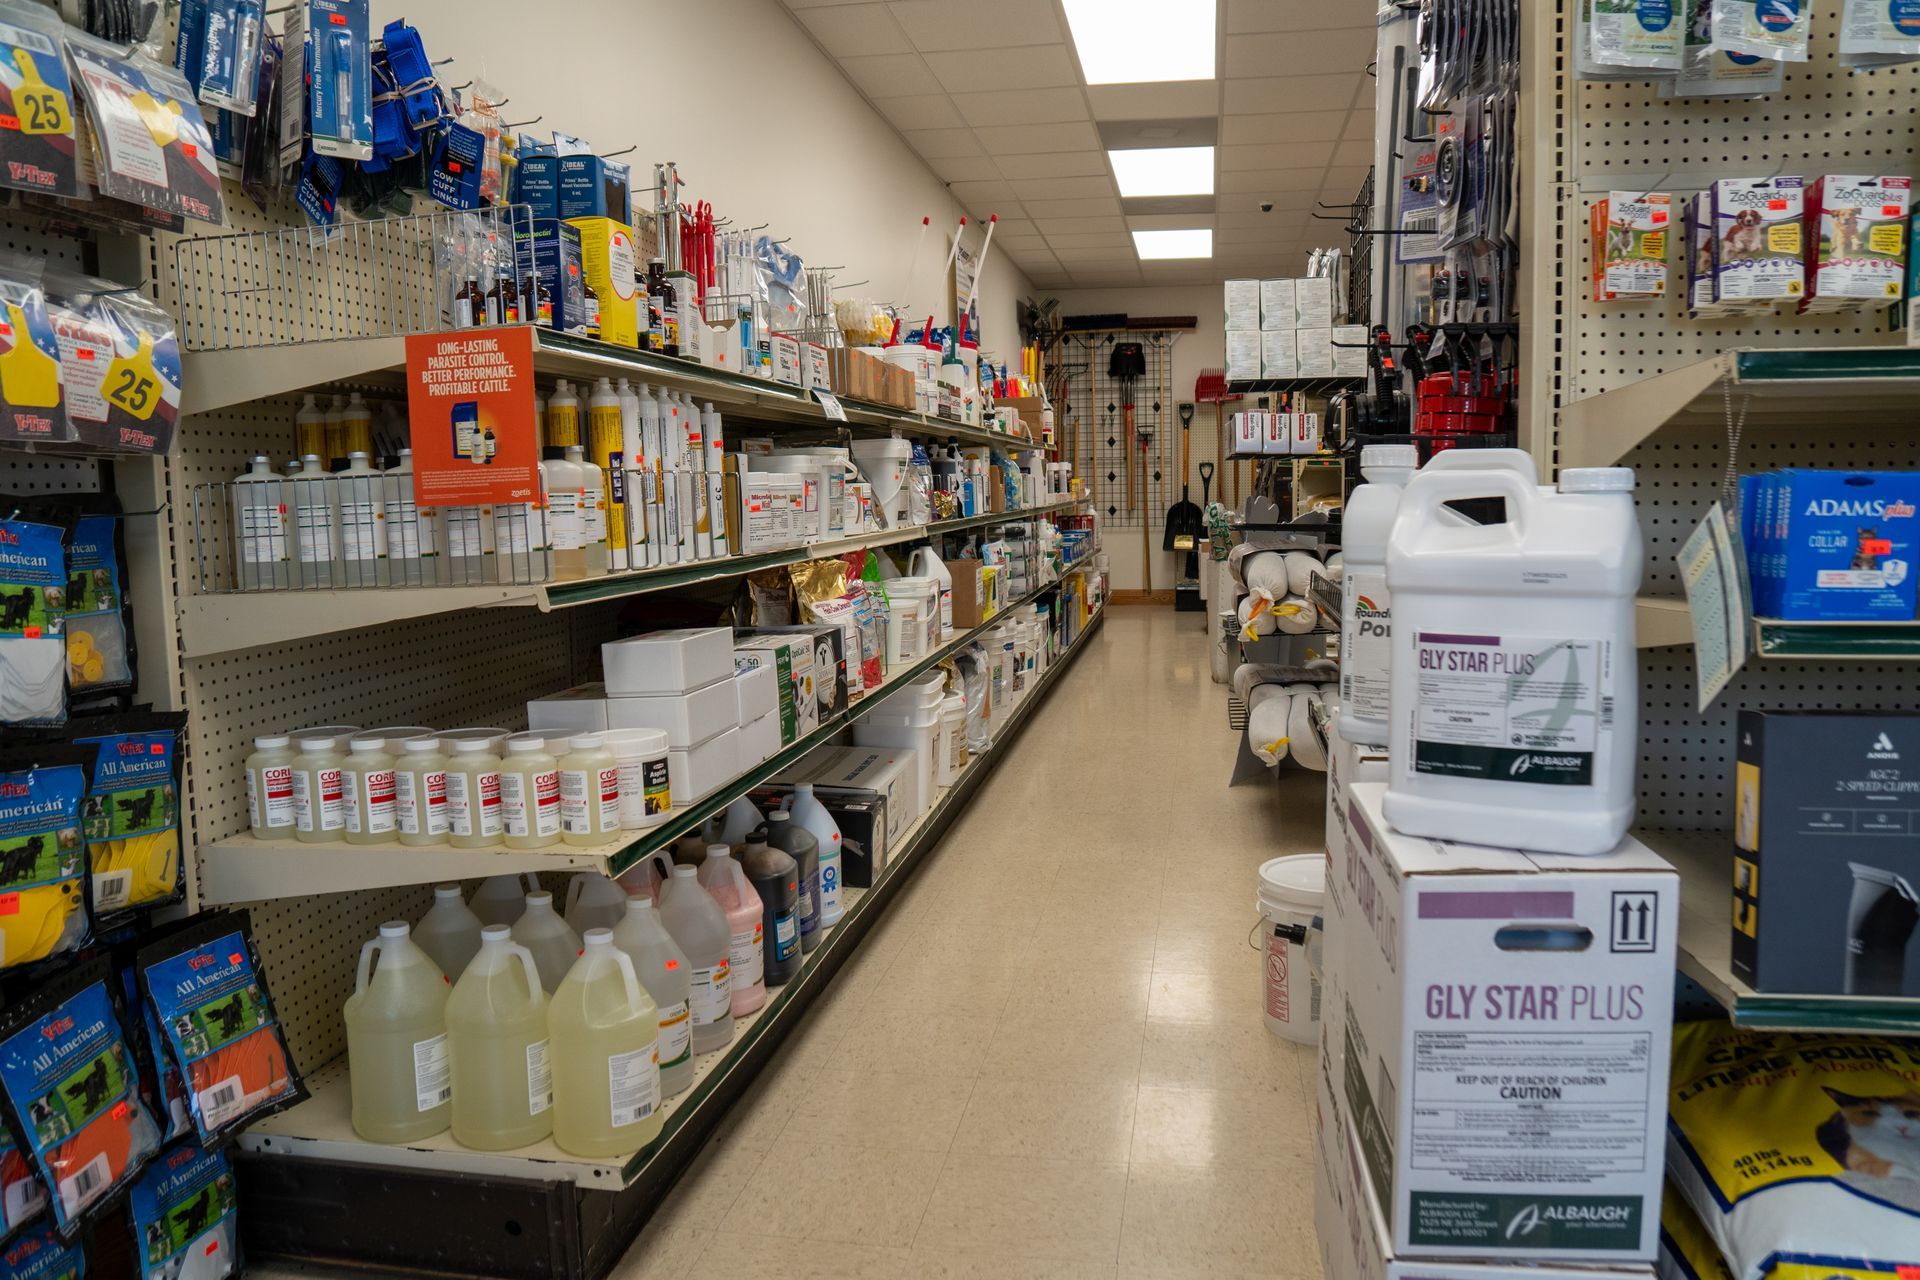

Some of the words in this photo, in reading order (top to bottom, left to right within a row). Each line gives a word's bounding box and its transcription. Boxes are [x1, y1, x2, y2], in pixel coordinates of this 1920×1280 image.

[25, 95, 61, 130] 25
[316, 92, 324, 119] Mercury
[433, 169, 454, 183] COW
[303, 177, 320, 197] COW
[432, 179, 455, 194] CUFF
[1834, 188, 1884, 200] ZoGuard
[301, 187, 321, 208] CUFF
[432, 188, 459, 205] LINKS
[1750, 201, 1768, 209] DOG
[299, 194, 320, 220] LINKS
[437, 338, 498, 356] LONG-LASTING
[428, 353, 467, 370] PARASITE
[468, 352, 509, 367] CONTROL.
[422, 369, 452, 384] BETTER
[454, 365, 517, 381] PERFORMANCE.
[110, 368, 154, 411] 25
[429, 380, 478, 396] PROFITABLE
[479, 379, 511, 393] CATTLE.
[511, 487, 531, 498] zoetis
[1804, 499, 1885, 517] ADAMS
[1882, 499, 1917, 522] plus
[71, 543, 97, 554] rican
[1808, 535, 1848, 548] COLLAR
[0, 552, 47, 566] merican
[1420, 648, 1446, 671] GLY
[1448, 650, 1489, 673] STAR
[1493, 652, 1536, 676] PLUS
[100, 761, 117, 777] All
[118, 758, 167, 774] American
[1530, 754, 1583, 768] ALBAUGH
[265, 767, 292, 779] CORI
[320, 770, 342, 781] COR
[426, 772, 446, 785] COR
[480, 774, 499, 786] COR
[0, 797, 63, 819] merican
[176, 980, 195, 998] All
[197, 962, 242, 991] American
[1426, 984, 1477, 1020] GLY
[1485, 984, 1559, 1020] STAR
[1571, 984, 1645, 1021] PLUS
[32, 1054, 54, 1076] All
[55, 1019, 105, 1055] American
[1800, 1047, 1900, 1065] POUR
[1456, 1074, 1479, 1085] KEEP
[1480, 1075, 1499, 1086] OUT
[1501, 1075, 1512, 1086] OF
[1516, 1075, 1545, 1086] REACH
[1547, 1076, 1559, 1086] OF
[1561, 1076, 1607, 1086] CHILDREN
[1500, 1086, 1562, 1100] CAUTION
[1733, 1154, 1755, 1170] 40
[1756, 1148, 1782, 1163] lbs
[1739, 1155, 1786, 1179] 18.14
[1787, 1154, 1814, 1168] kg
[156, 1181, 169, 1199] All
[170, 1152, 217, 1187] American
[1419, 1199, 1475, 1209] Manufactured
[1542, 1205, 1630, 1221] ALBAUGH
[1475, 1220, 1498, 1229] Street
